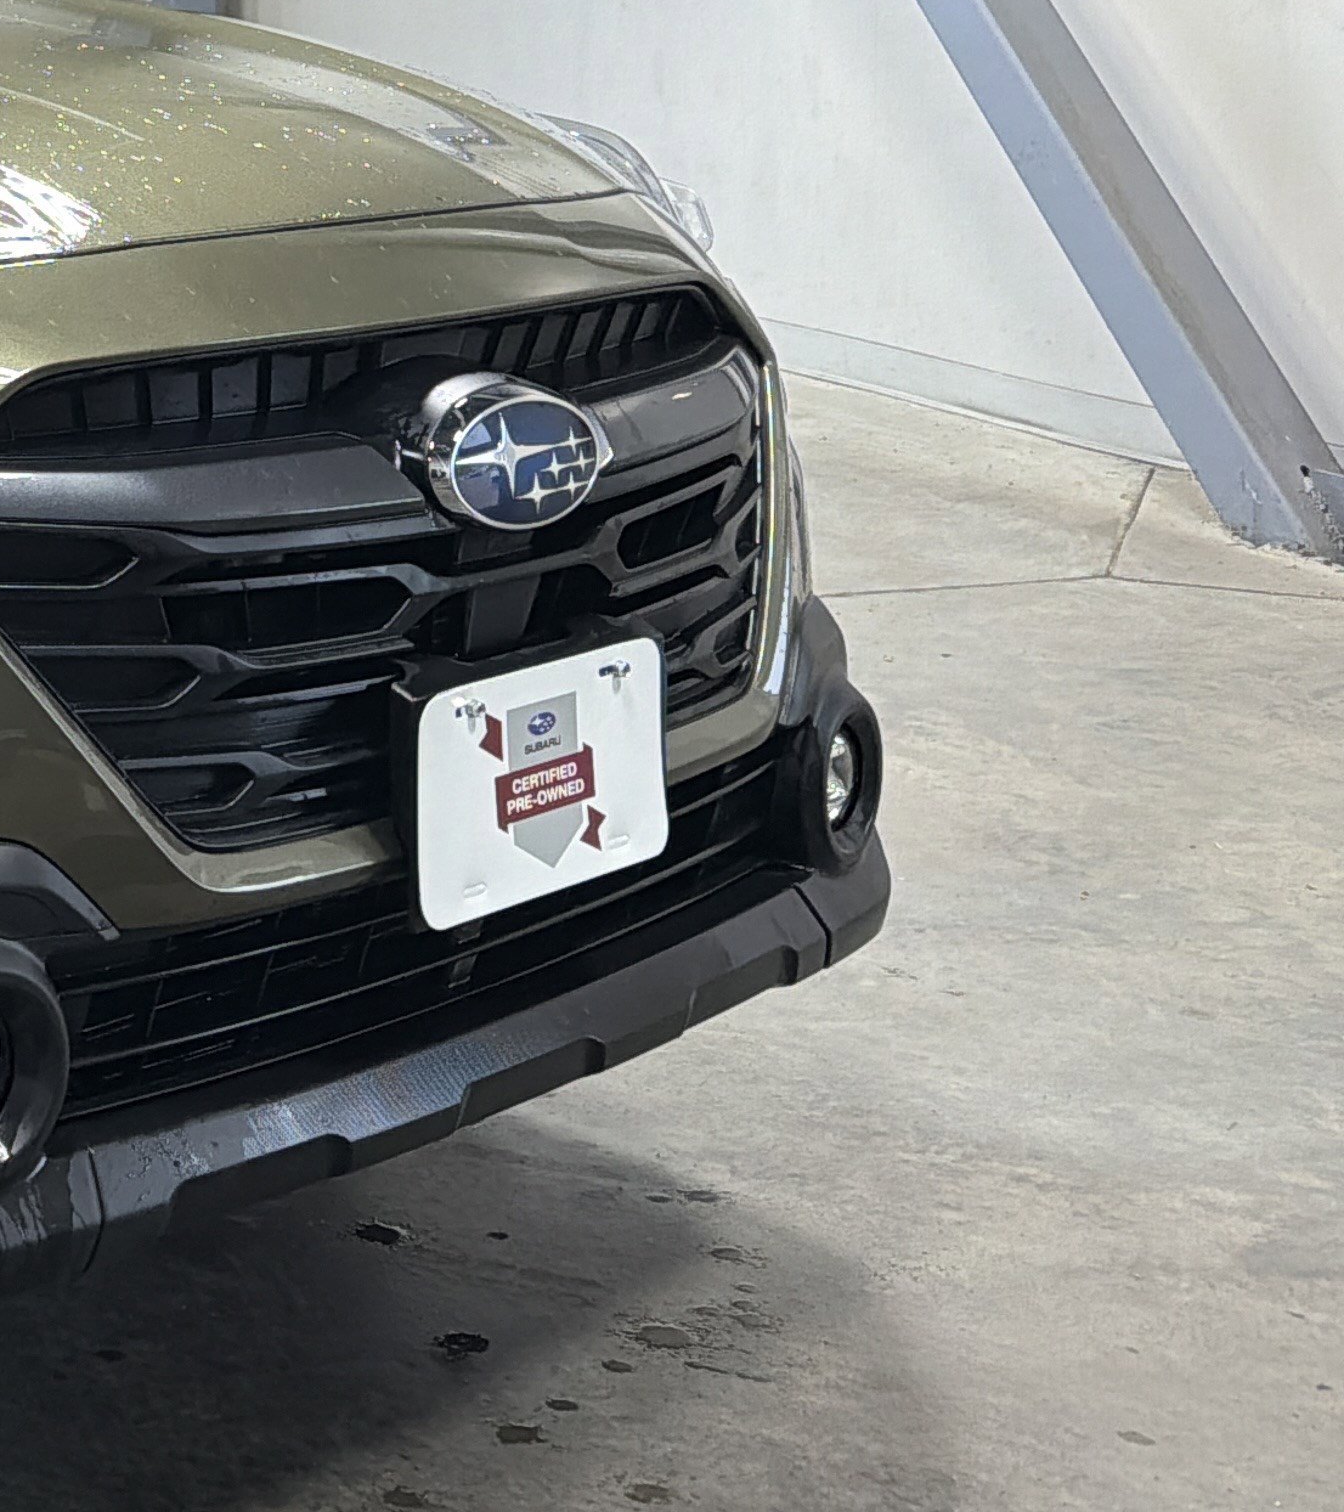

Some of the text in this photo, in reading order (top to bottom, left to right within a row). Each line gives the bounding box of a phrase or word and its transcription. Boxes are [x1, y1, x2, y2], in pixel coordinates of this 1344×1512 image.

[524, 734, 561, 755] SUBARU
[512, 761, 578, 795] CERTIFIED
[506, 778, 585, 816] PRE-OWNED
